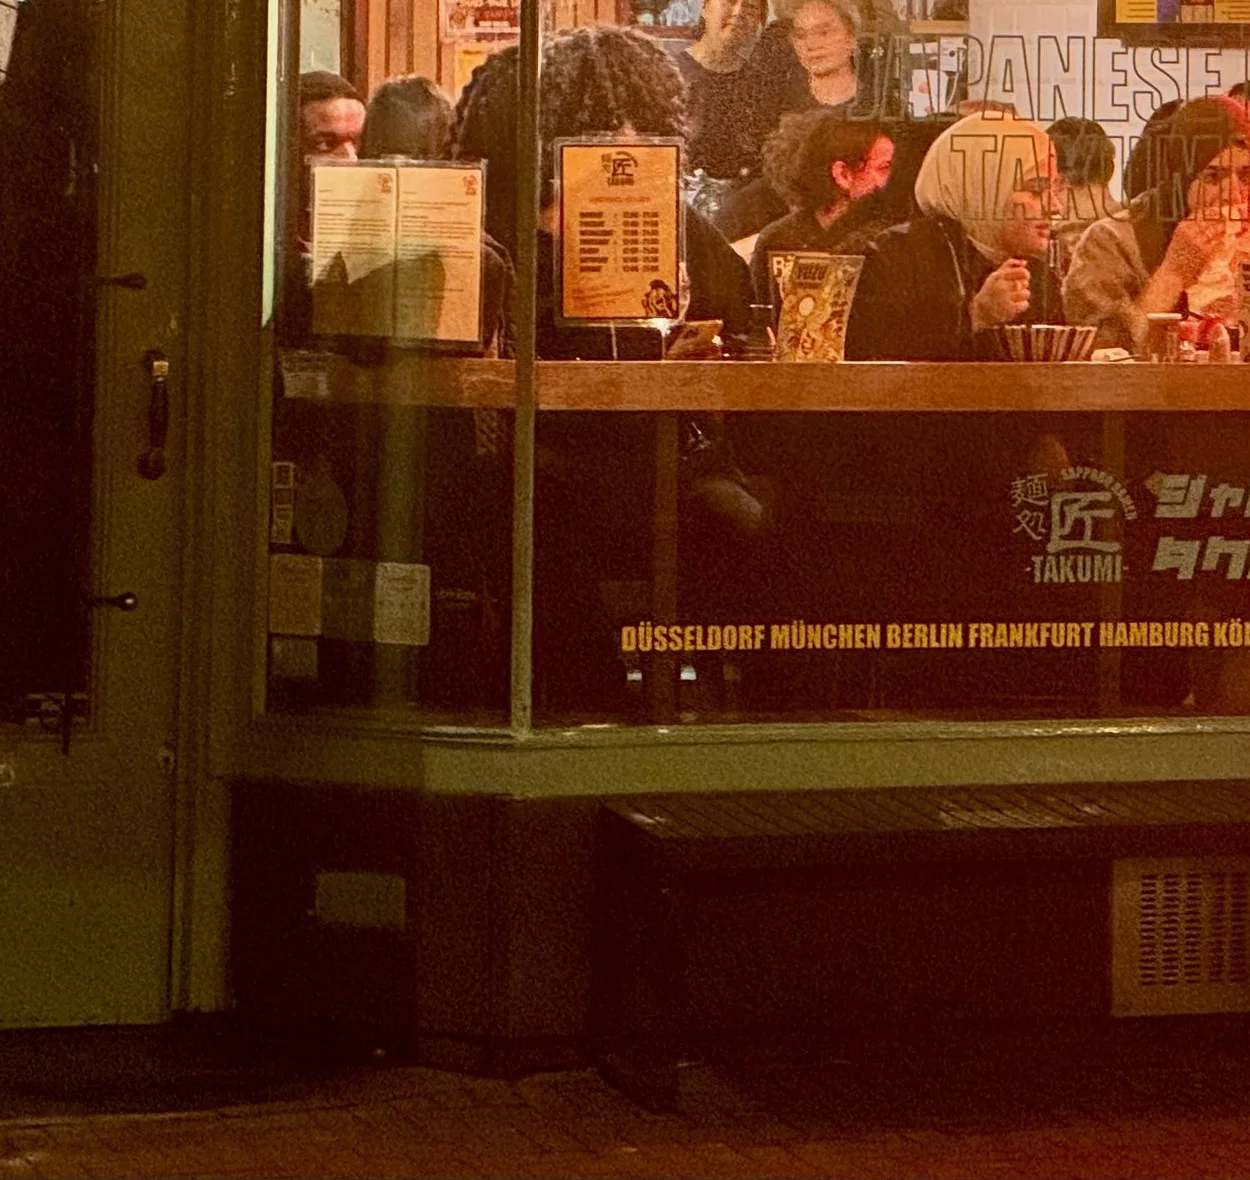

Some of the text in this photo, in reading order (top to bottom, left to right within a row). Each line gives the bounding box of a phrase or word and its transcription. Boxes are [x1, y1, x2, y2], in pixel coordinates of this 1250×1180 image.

[1060, 465, 1138, 520] SAPPORO RAMEN
[1046, 491, 1123, 554] 匠
[621, 621, 765, 652] DÜSSELDORF
[770, 620, 881, 650] MÜNCHEN
[886, 623, 963, 649] BERLIN
[968, 622, 1095, 648] FRANKFURT
[1099, 622, 1209, 648] HAMBURG
